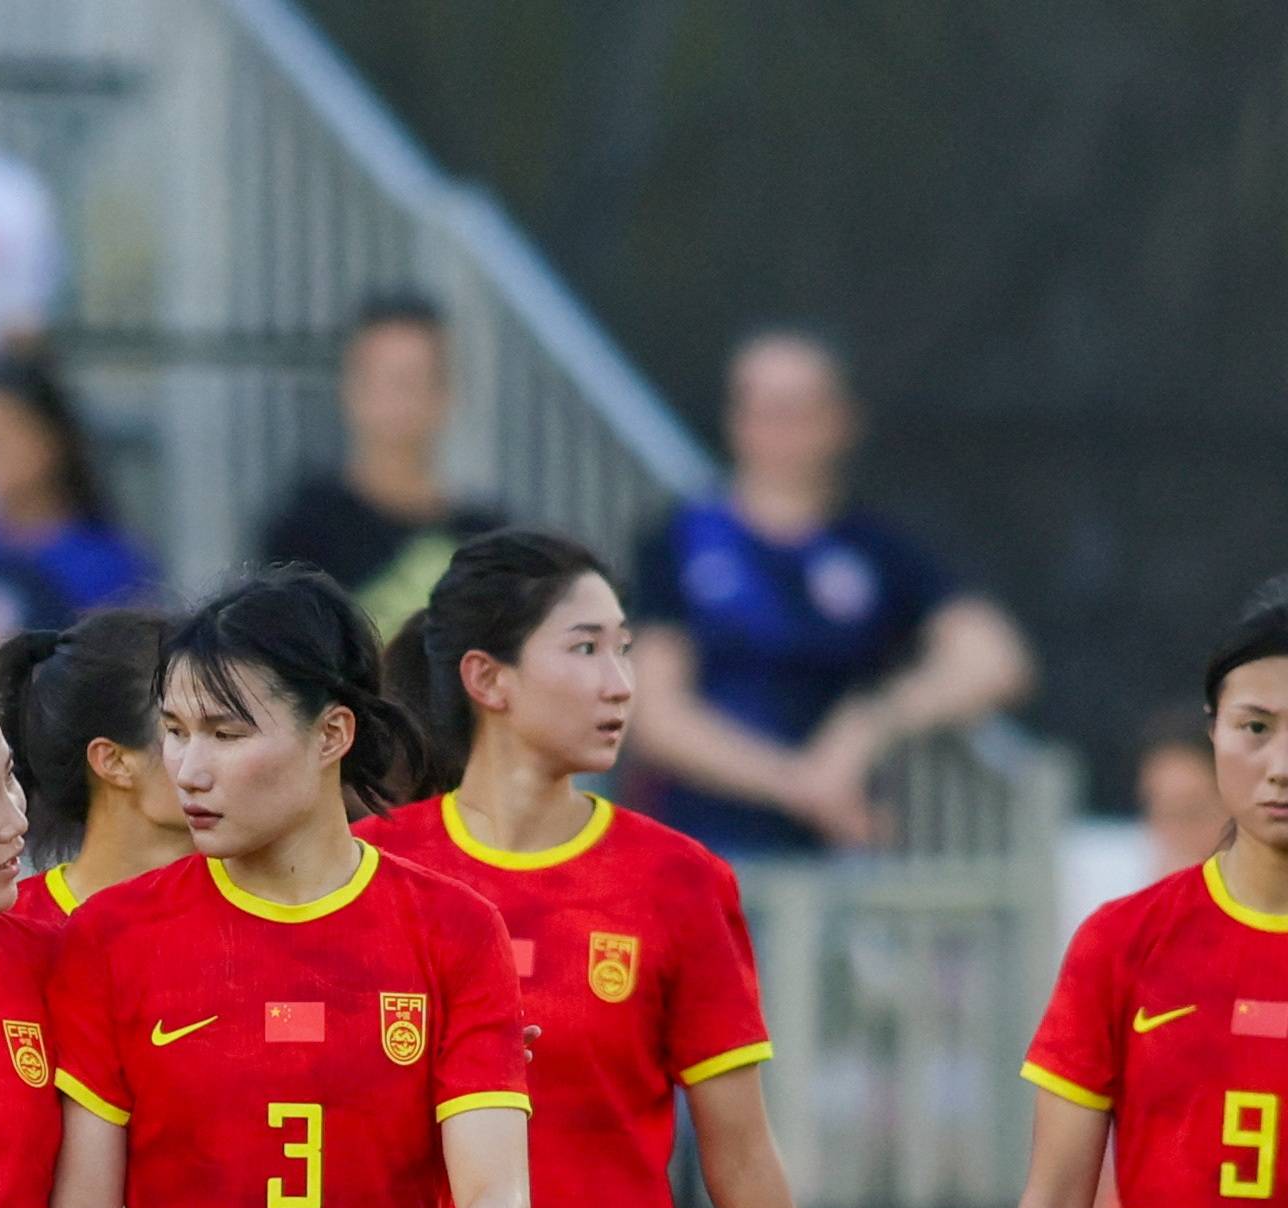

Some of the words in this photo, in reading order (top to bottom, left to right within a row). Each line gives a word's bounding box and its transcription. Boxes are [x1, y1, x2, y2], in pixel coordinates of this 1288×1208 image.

[384, 997, 422, 1012] CFA
[7, 1025, 40, 1040] CFA
[1219, 1091, 1279, 1198] 9
